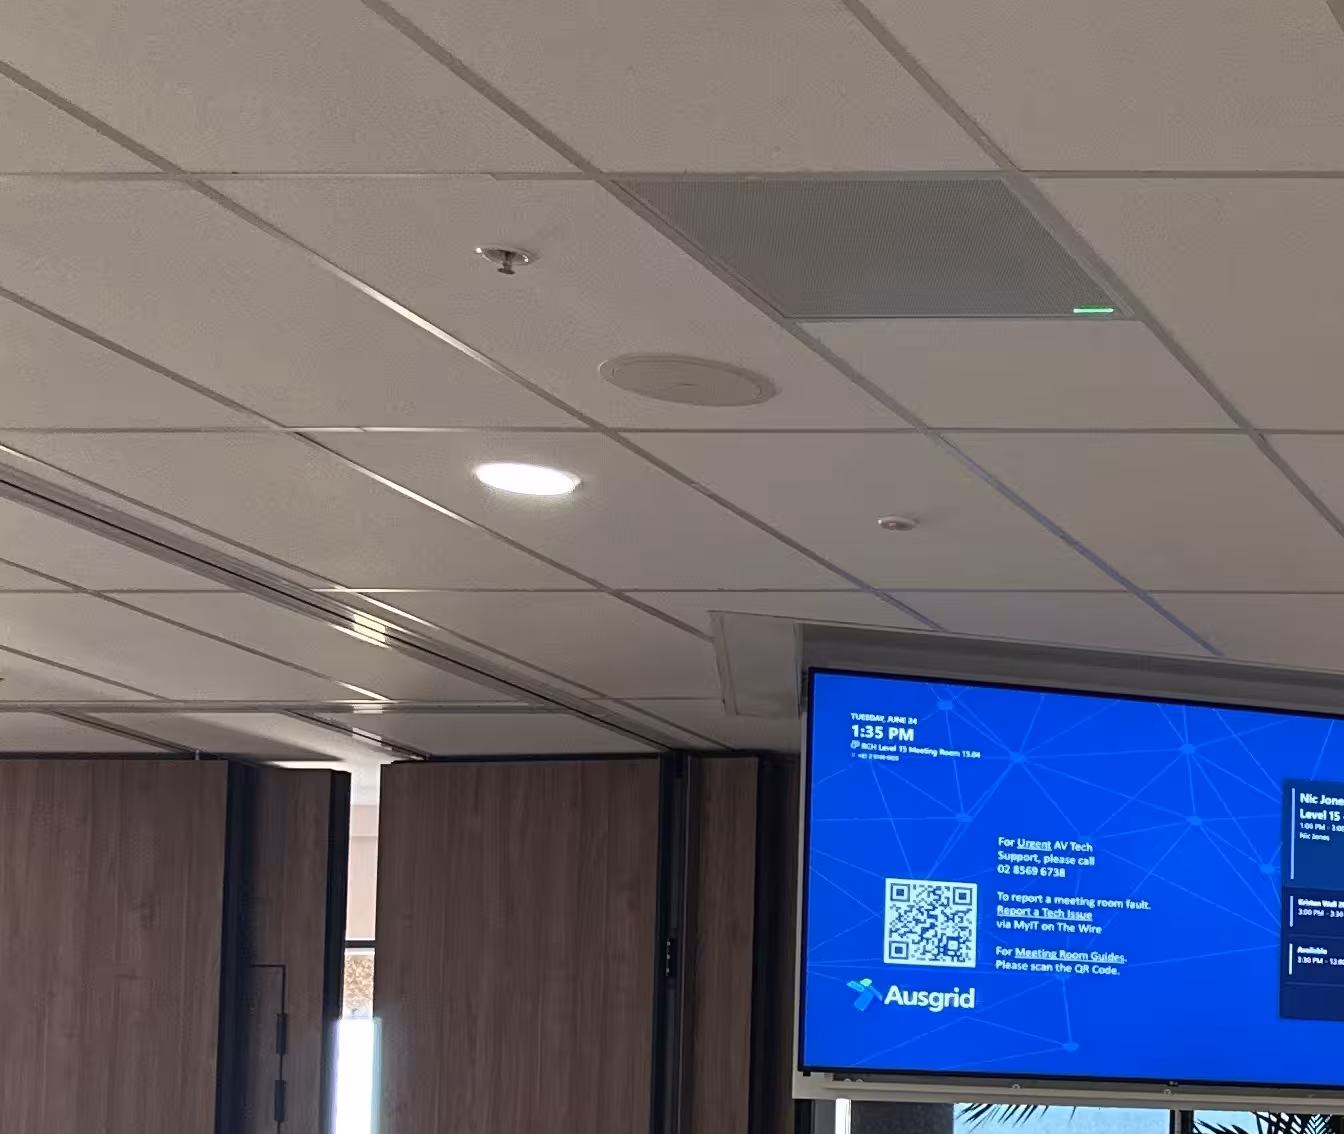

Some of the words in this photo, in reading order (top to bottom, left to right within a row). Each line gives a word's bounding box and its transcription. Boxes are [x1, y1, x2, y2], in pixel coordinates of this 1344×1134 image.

[852, 724, 884, 739] 1:35
[888, 727, 914, 741] PM
[1300, 793, 1318, 804] Nic
[1300, 809, 1327, 820] Level
[1329, 811, 1340, 822] 15
[998, 837, 1015, 848] For
[1017, 838, 1053, 851] Urgent
[1054, 841, 1068, 850] AV
[1070, 841, 1093, 852] Tech
[998, 851, 1041, 864] Support,
[1044, 854, 1076, 866] please
[1078, 856, 1095, 866] call
[997, 864, 1010, 874] 02
[1013, 865, 1038, 876] 8569
[1040, 866, 1066, 878] 6738
[997, 891, 1009, 901] To
[1011, 893, 1043, 904] report
[1045, 896, 1052, 904] a
[1054, 895, 1095, 908] meeting
[1097, 899, 1124, 908] room
[997, 905, 1032, 917] Report
[1033, 909, 1040, 917] a
[1042, 907, 1065, 919] Tech
[1067, 910, 1093, 921] Issue
[996, 920, 1011, 929] via
[1014, 920, 1039, 931] MyIT
[1041, 923, 1055, 931] on
[1057, 921, 1075, 932] The
[1078, 924, 1102, 934] Wire
[996, 946, 1013, 957] For
[1015, 947, 1057, 960] Meeting
[1060, 950, 1088, 962] Room
[995, 960, 1028, 971] Please
[1031, 963, 1053, 972] scan
[1055, 963, 1072, 973] the
[1075, 965, 1090, 974] QR
[1092, 965, 1121, 976] Code.
[884, 985, 975, 1012] Ausgrid
